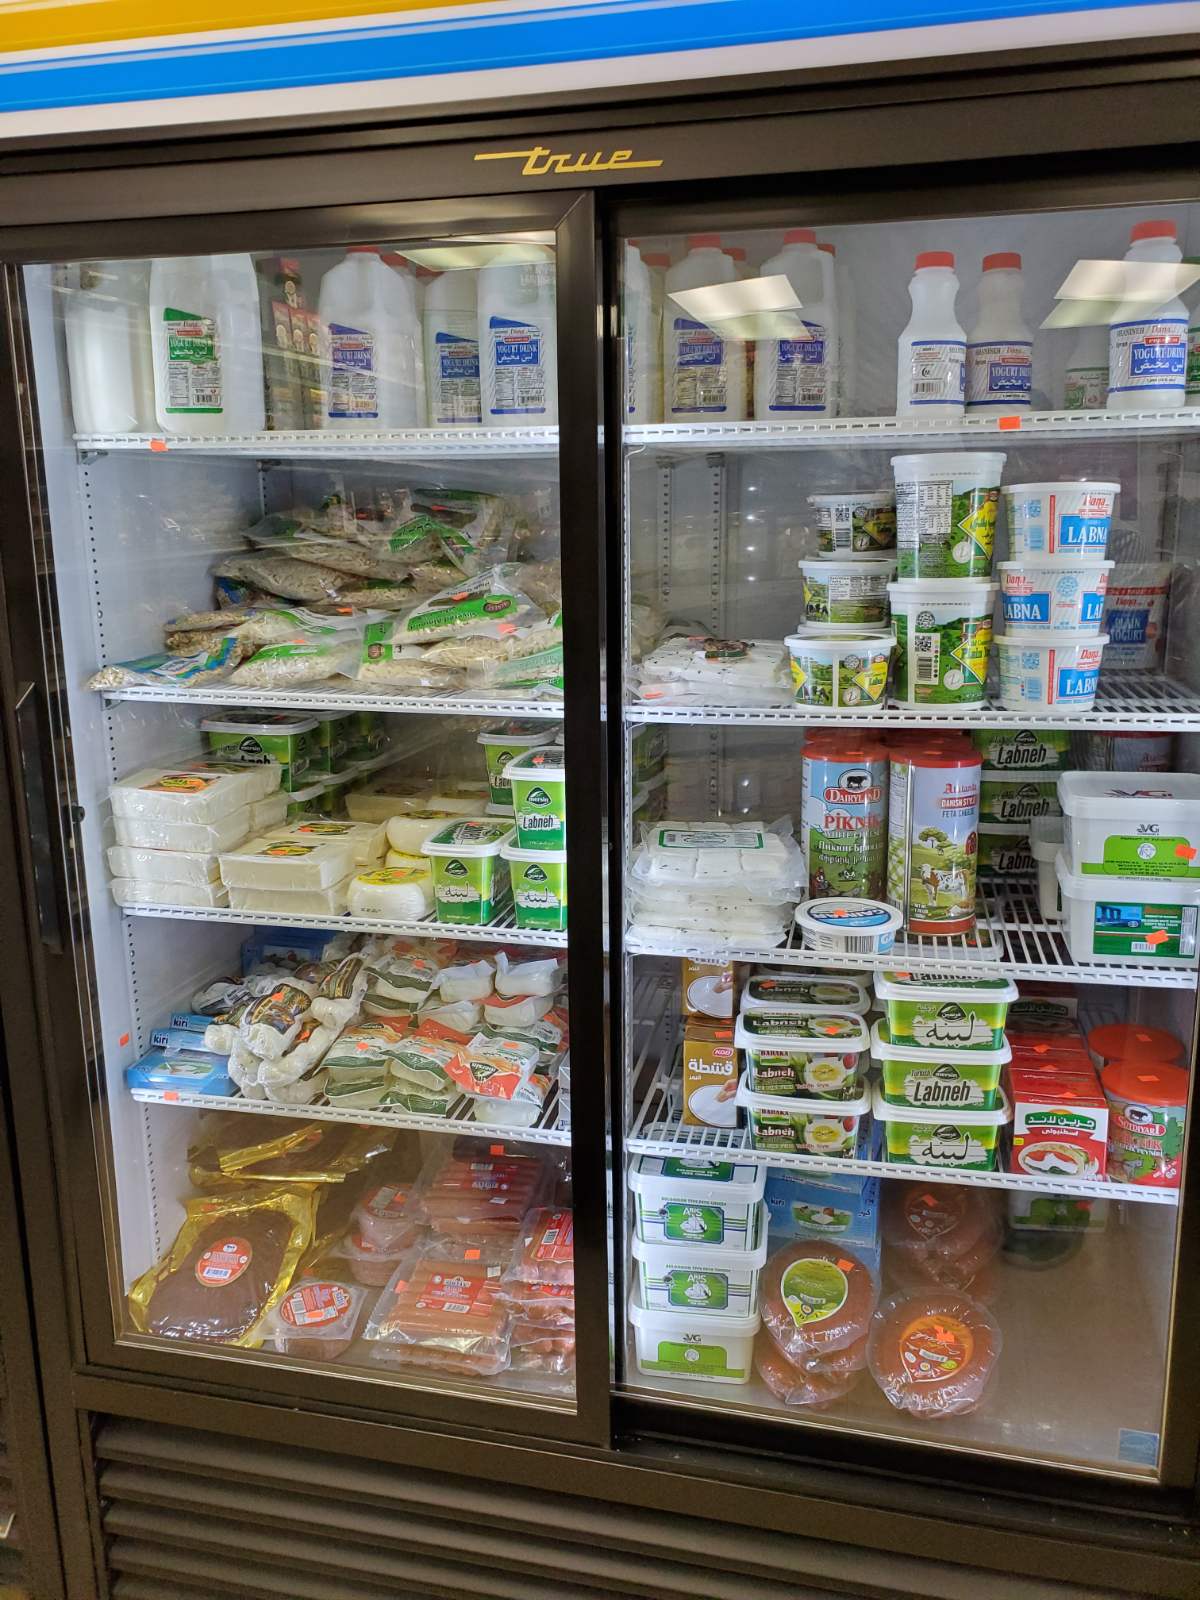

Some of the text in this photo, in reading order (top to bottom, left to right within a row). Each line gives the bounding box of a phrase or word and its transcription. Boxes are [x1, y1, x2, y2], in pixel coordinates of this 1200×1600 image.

[997, 743, 1047, 764] Labneh
[1001, 798, 1050, 818] Labneh
[523, 816, 553, 829] Labneh
[173, 1017, 188, 1028] kiri
[153, 1034, 169, 1044] kiri
[753, 1067, 795, 1079] Labneh
[914, 1080, 971, 1102] Labneh
[754, 1124, 795, 1137] Labneh
